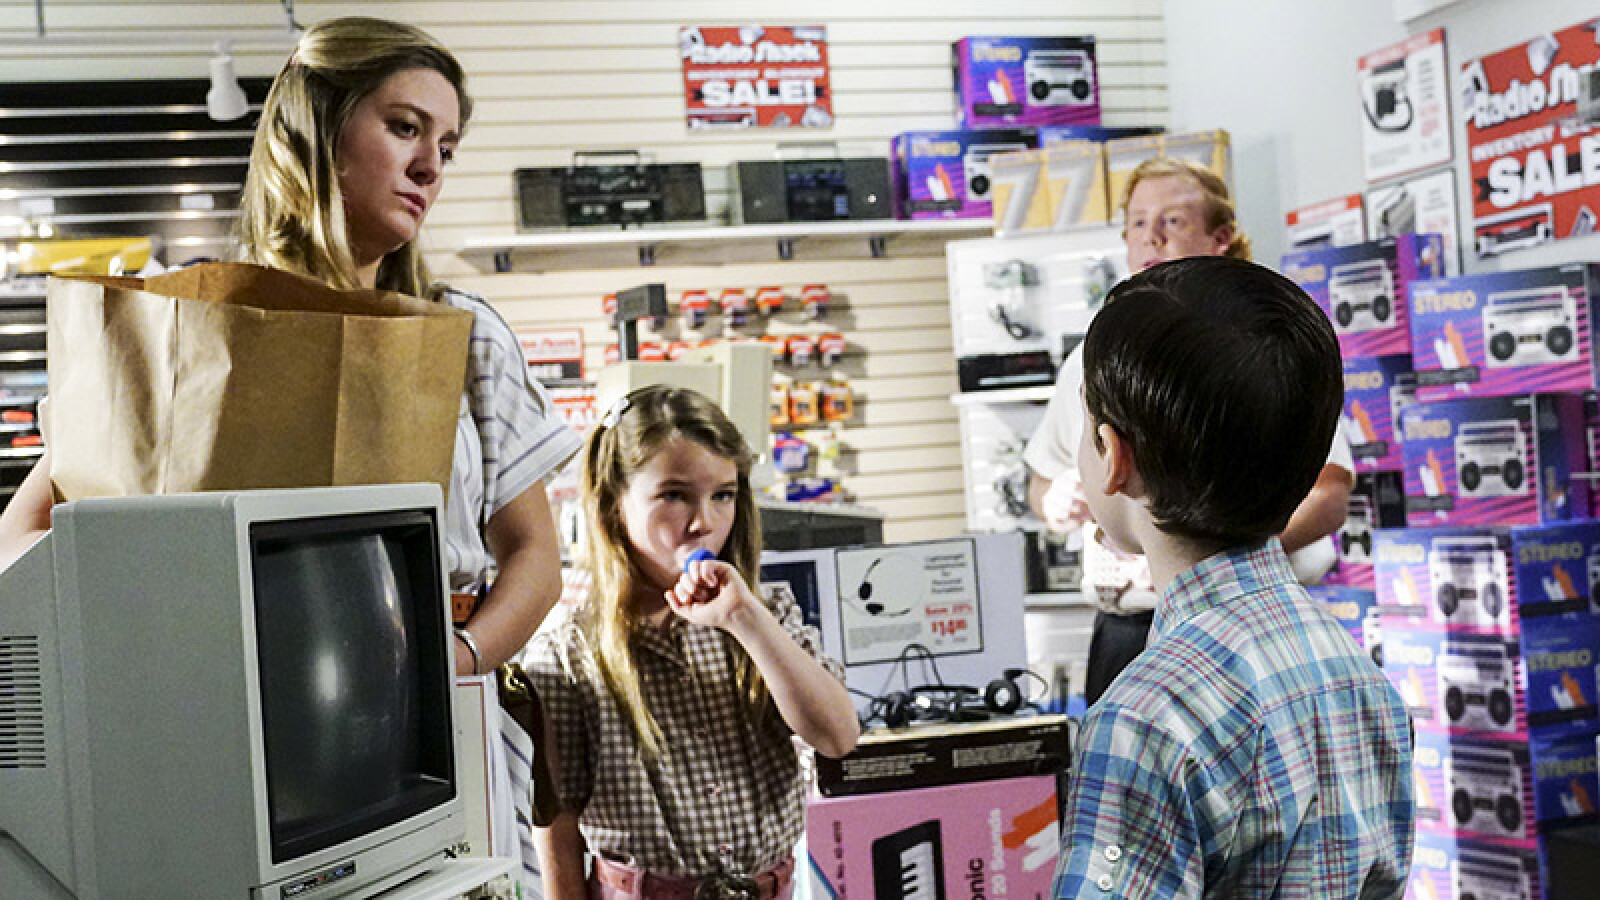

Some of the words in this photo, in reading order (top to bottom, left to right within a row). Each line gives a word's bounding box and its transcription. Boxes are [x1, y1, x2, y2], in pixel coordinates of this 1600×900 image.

[702, 80, 816, 107] SALE!
[1414, 289, 1476, 314] STEREO
[1519, 541, 1584, 564] STEREO
[1527, 649, 1591, 672] STEREO
